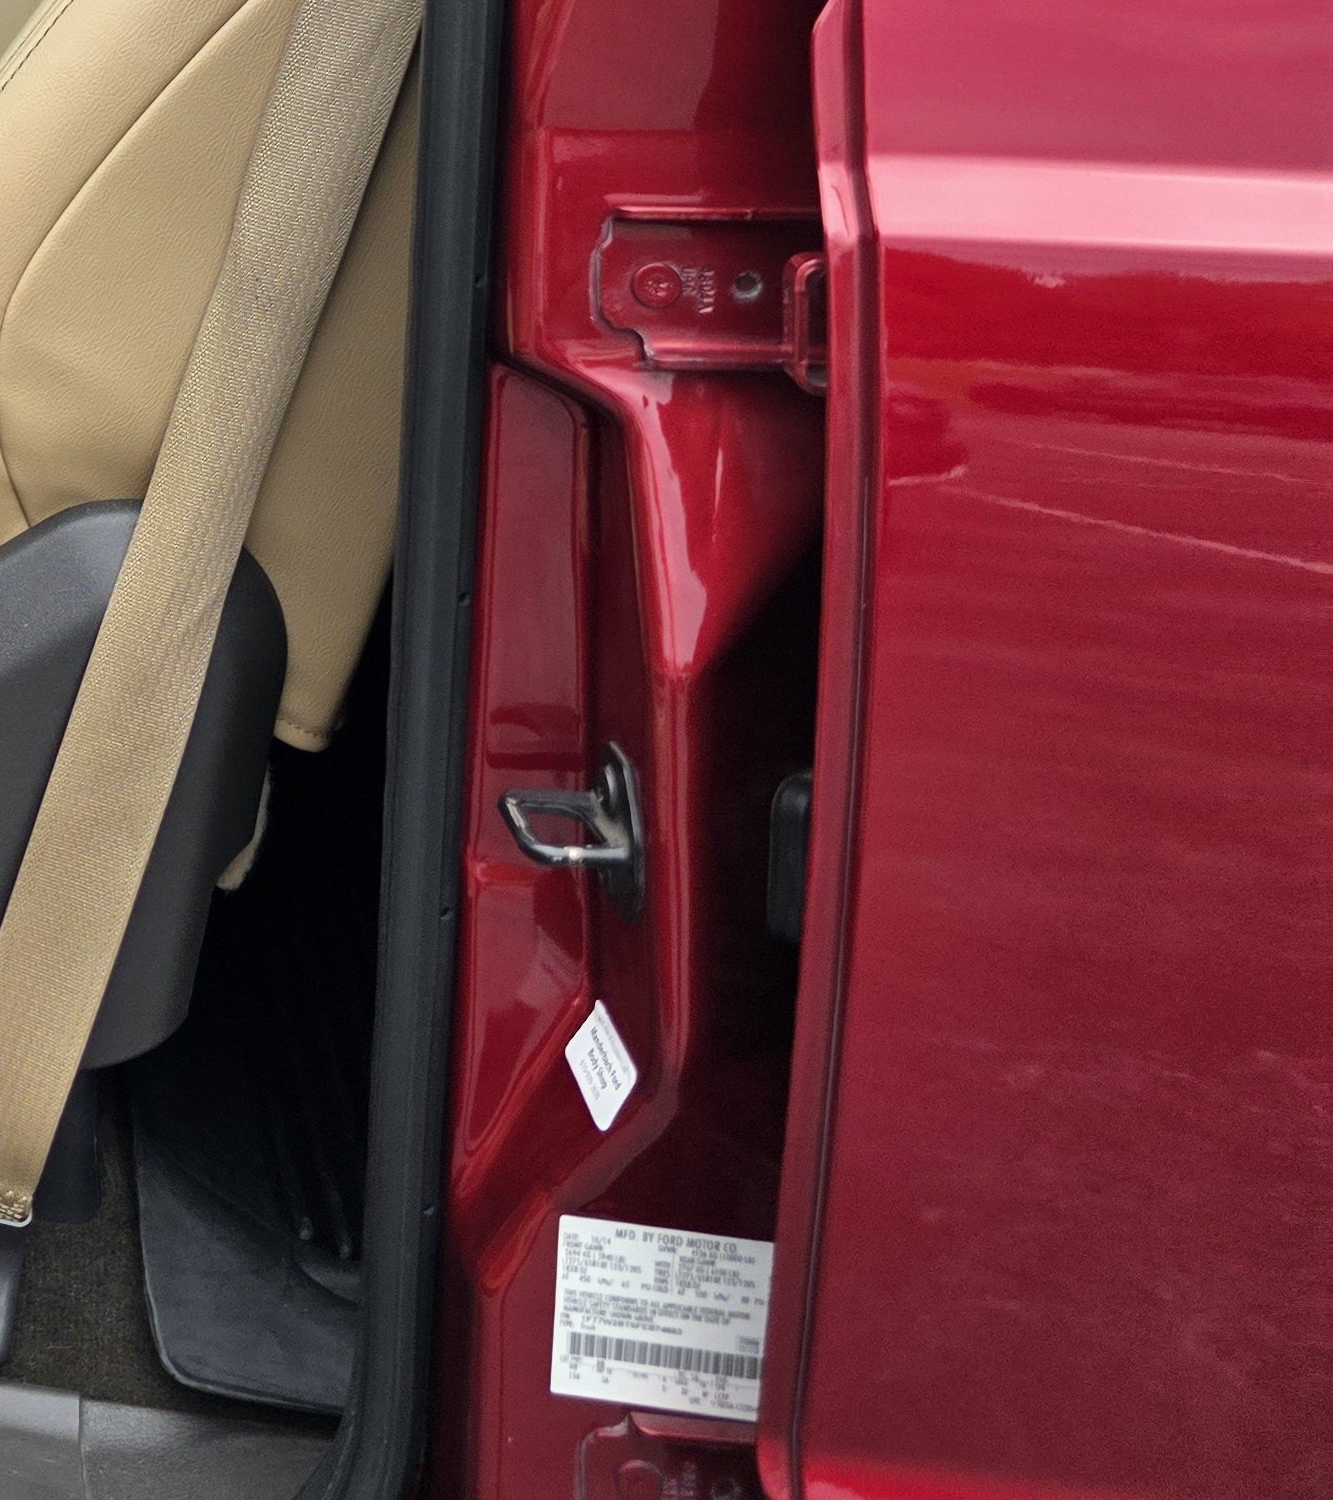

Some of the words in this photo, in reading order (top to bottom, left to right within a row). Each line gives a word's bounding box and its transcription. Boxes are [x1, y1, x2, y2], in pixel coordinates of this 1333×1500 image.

[587, 1047, 599, 1072] Body
[596, 1066, 608, 1090] Shop
[610, 1069, 622, 1091] Ford
[642, 1231, 654, 1242] BY
[656, 1233, 683, 1246] FORD
[685, 1237, 720, 1251] MOTOR
